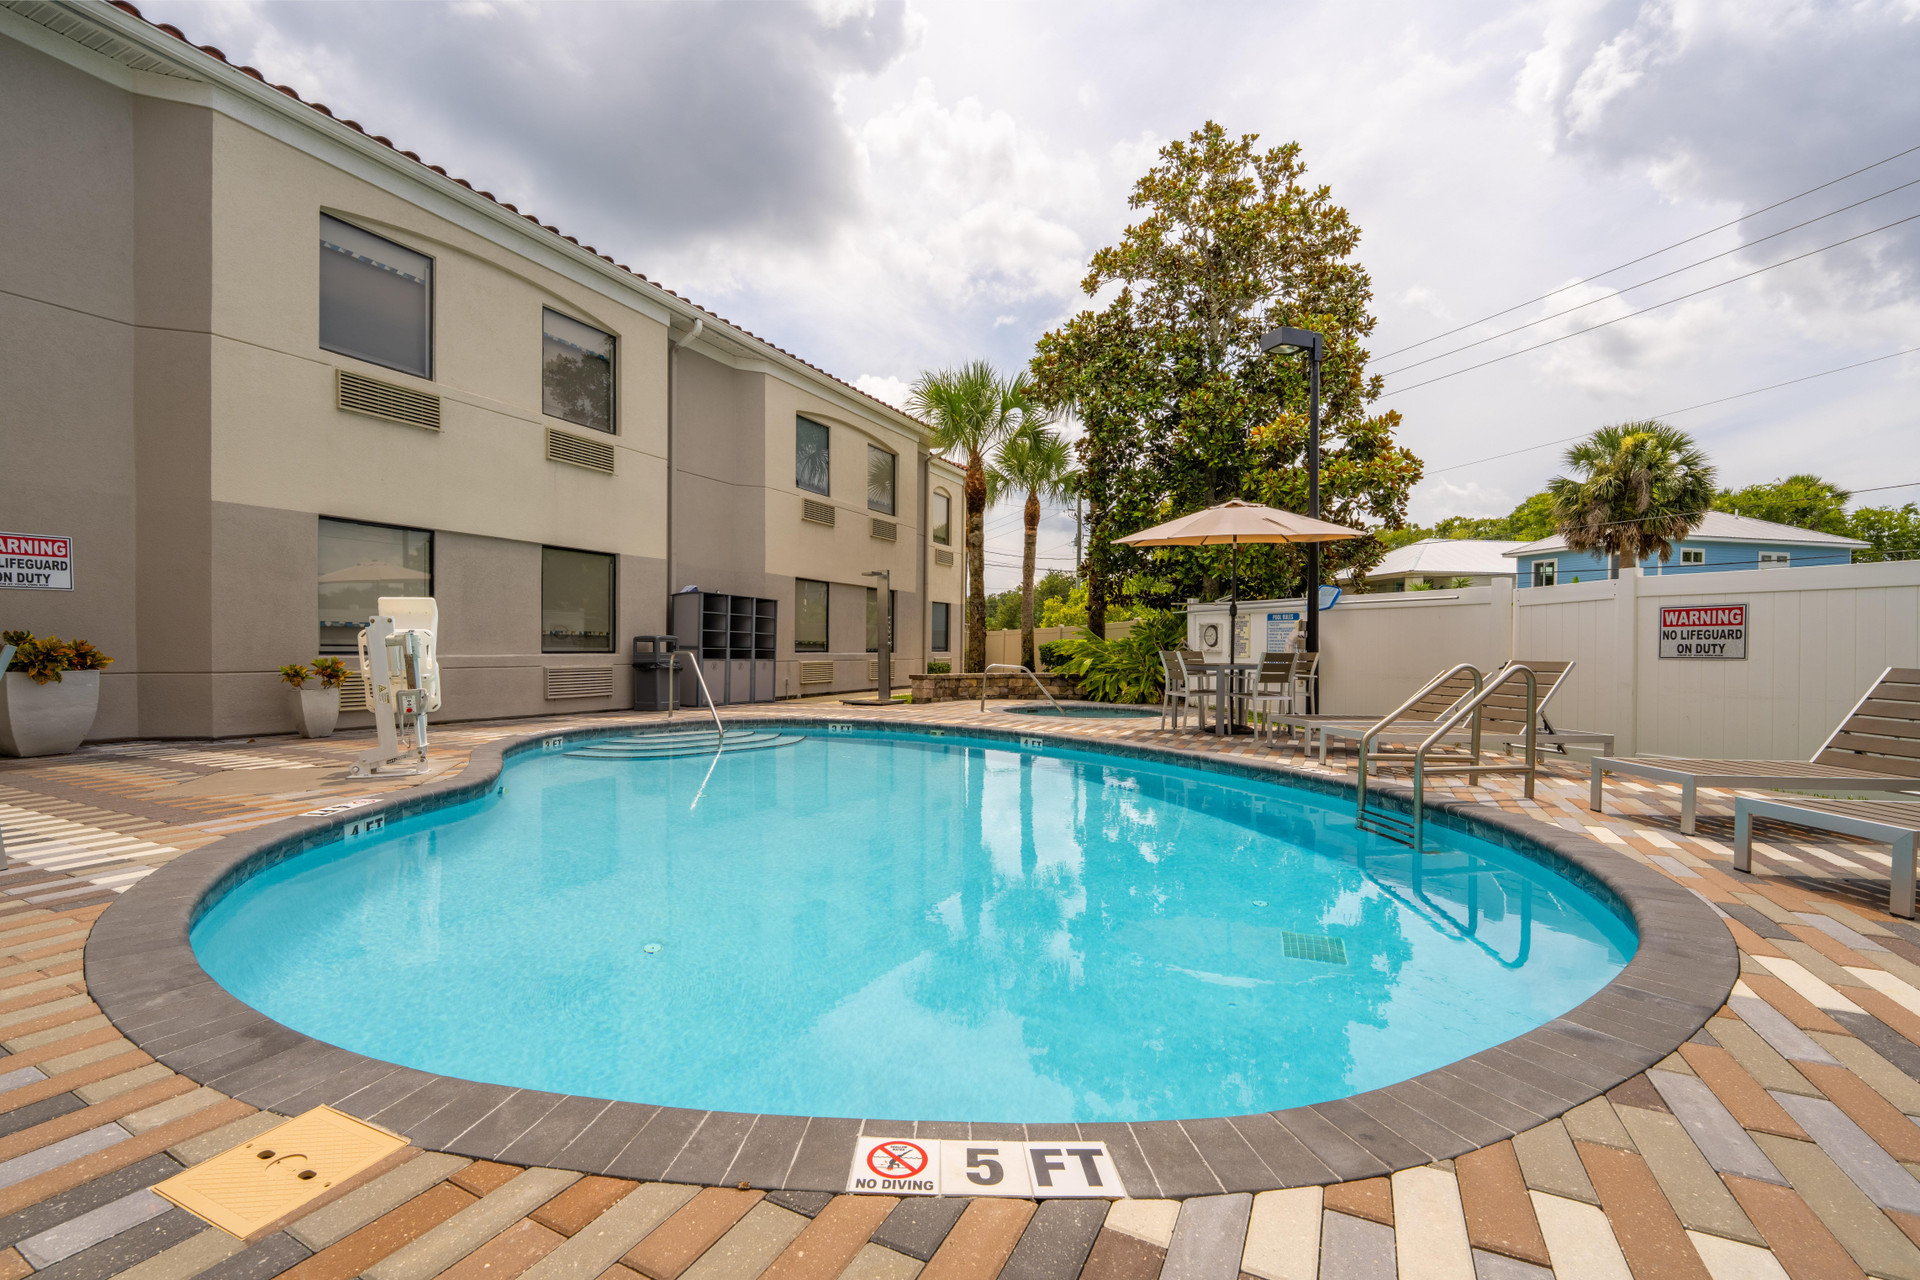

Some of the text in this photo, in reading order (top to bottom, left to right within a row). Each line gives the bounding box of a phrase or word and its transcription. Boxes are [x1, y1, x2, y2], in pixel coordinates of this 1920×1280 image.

[0, 537, 66, 556] ARNING
[17, 572, 51, 584] DUTY
[1664, 609, 1742, 625] WARNING
[1663, 629, 1742, 640] NO LIFEGUARD
[1677, 643, 1726, 654] ON DUTY
[366, 817, 384, 832] FT
[966, 1147, 1104, 1187] 5 FT
[855, 1178, 934, 1191] NO DIVING
